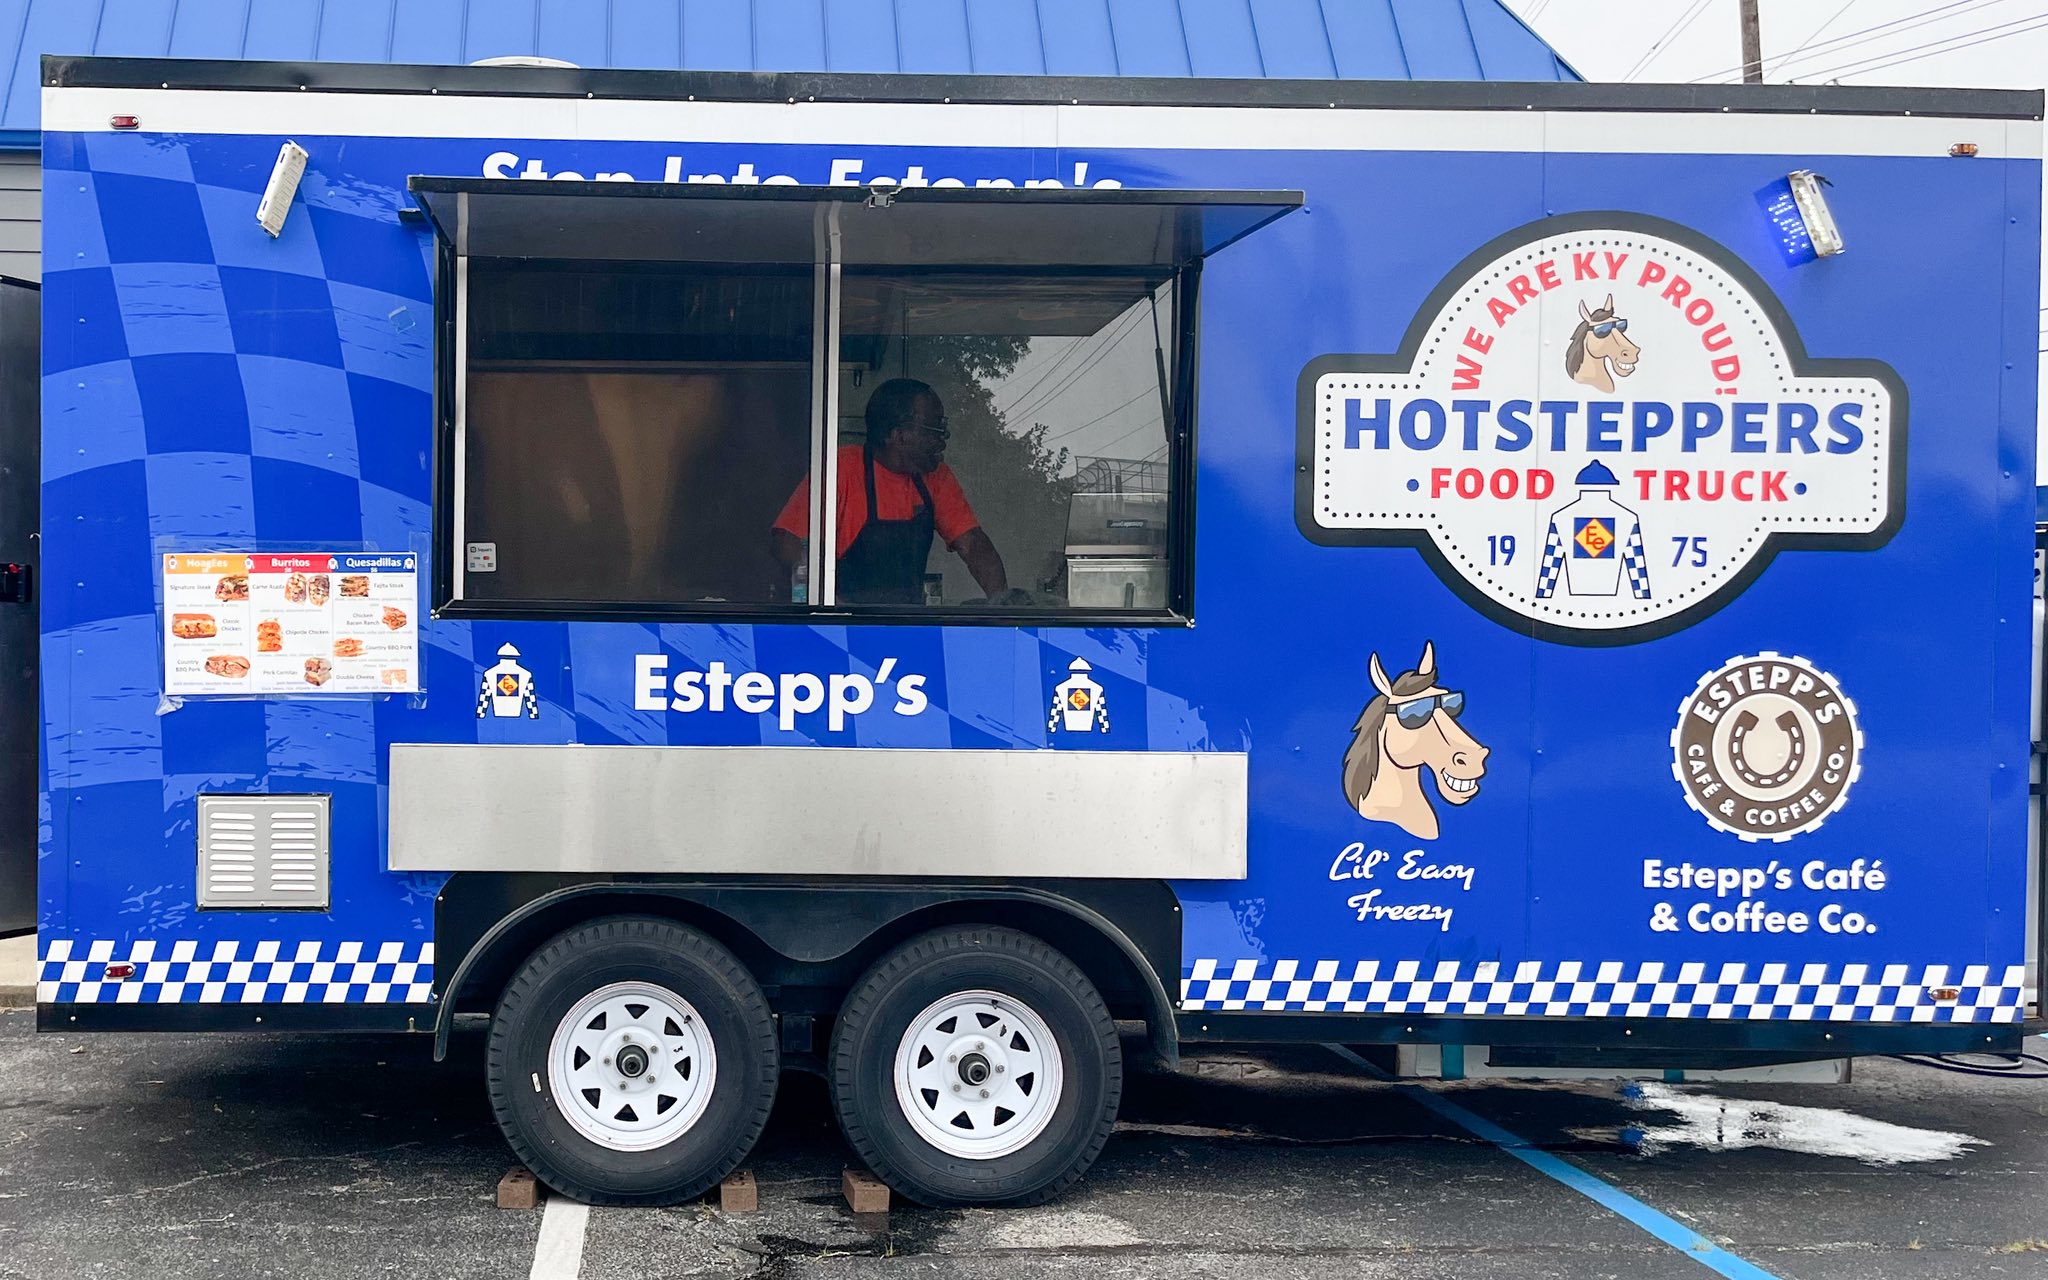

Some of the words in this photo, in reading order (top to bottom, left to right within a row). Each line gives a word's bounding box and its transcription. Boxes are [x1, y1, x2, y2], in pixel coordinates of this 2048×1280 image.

[1451, 326, 1495, 391] WE
[1486, 259, 1562, 328] ARE
[1572, 251, 1629, 281] KY
[1637, 260, 1741, 395] PROUD!
[1343, 398, 1864, 455] HOTSTEPPERS
[1430, 468, 1554, 500] FOOD
[1633, 470, 1789, 502] TRUCK
[271, 558, 311, 567] Burritos
[345, 557, 402, 568] Quesadillas
[1487, 535, 1516, 567] 19
[1672, 537, 1708, 568] 75
[633, 653, 928, 732] Estepp's
[1692, 665, 1842, 724] ESTEPP'S
[1718, 798, 1736, 818] &
[1745, 788, 1827, 826] COFFEE
[1822, 744, 1847, 784] CO.
[1397, 848, 1476, 890] Easy
[1643, 860, 1793, 897] Estepp's
[1802, 859, 1886, 890] Café
[1347, 889, 1452, 931] Freezy
[1649, 903, 1679, 933] &
[1687, 903, 1809, 933] Coffee
[1818, 905, 1877, 934] Co.
